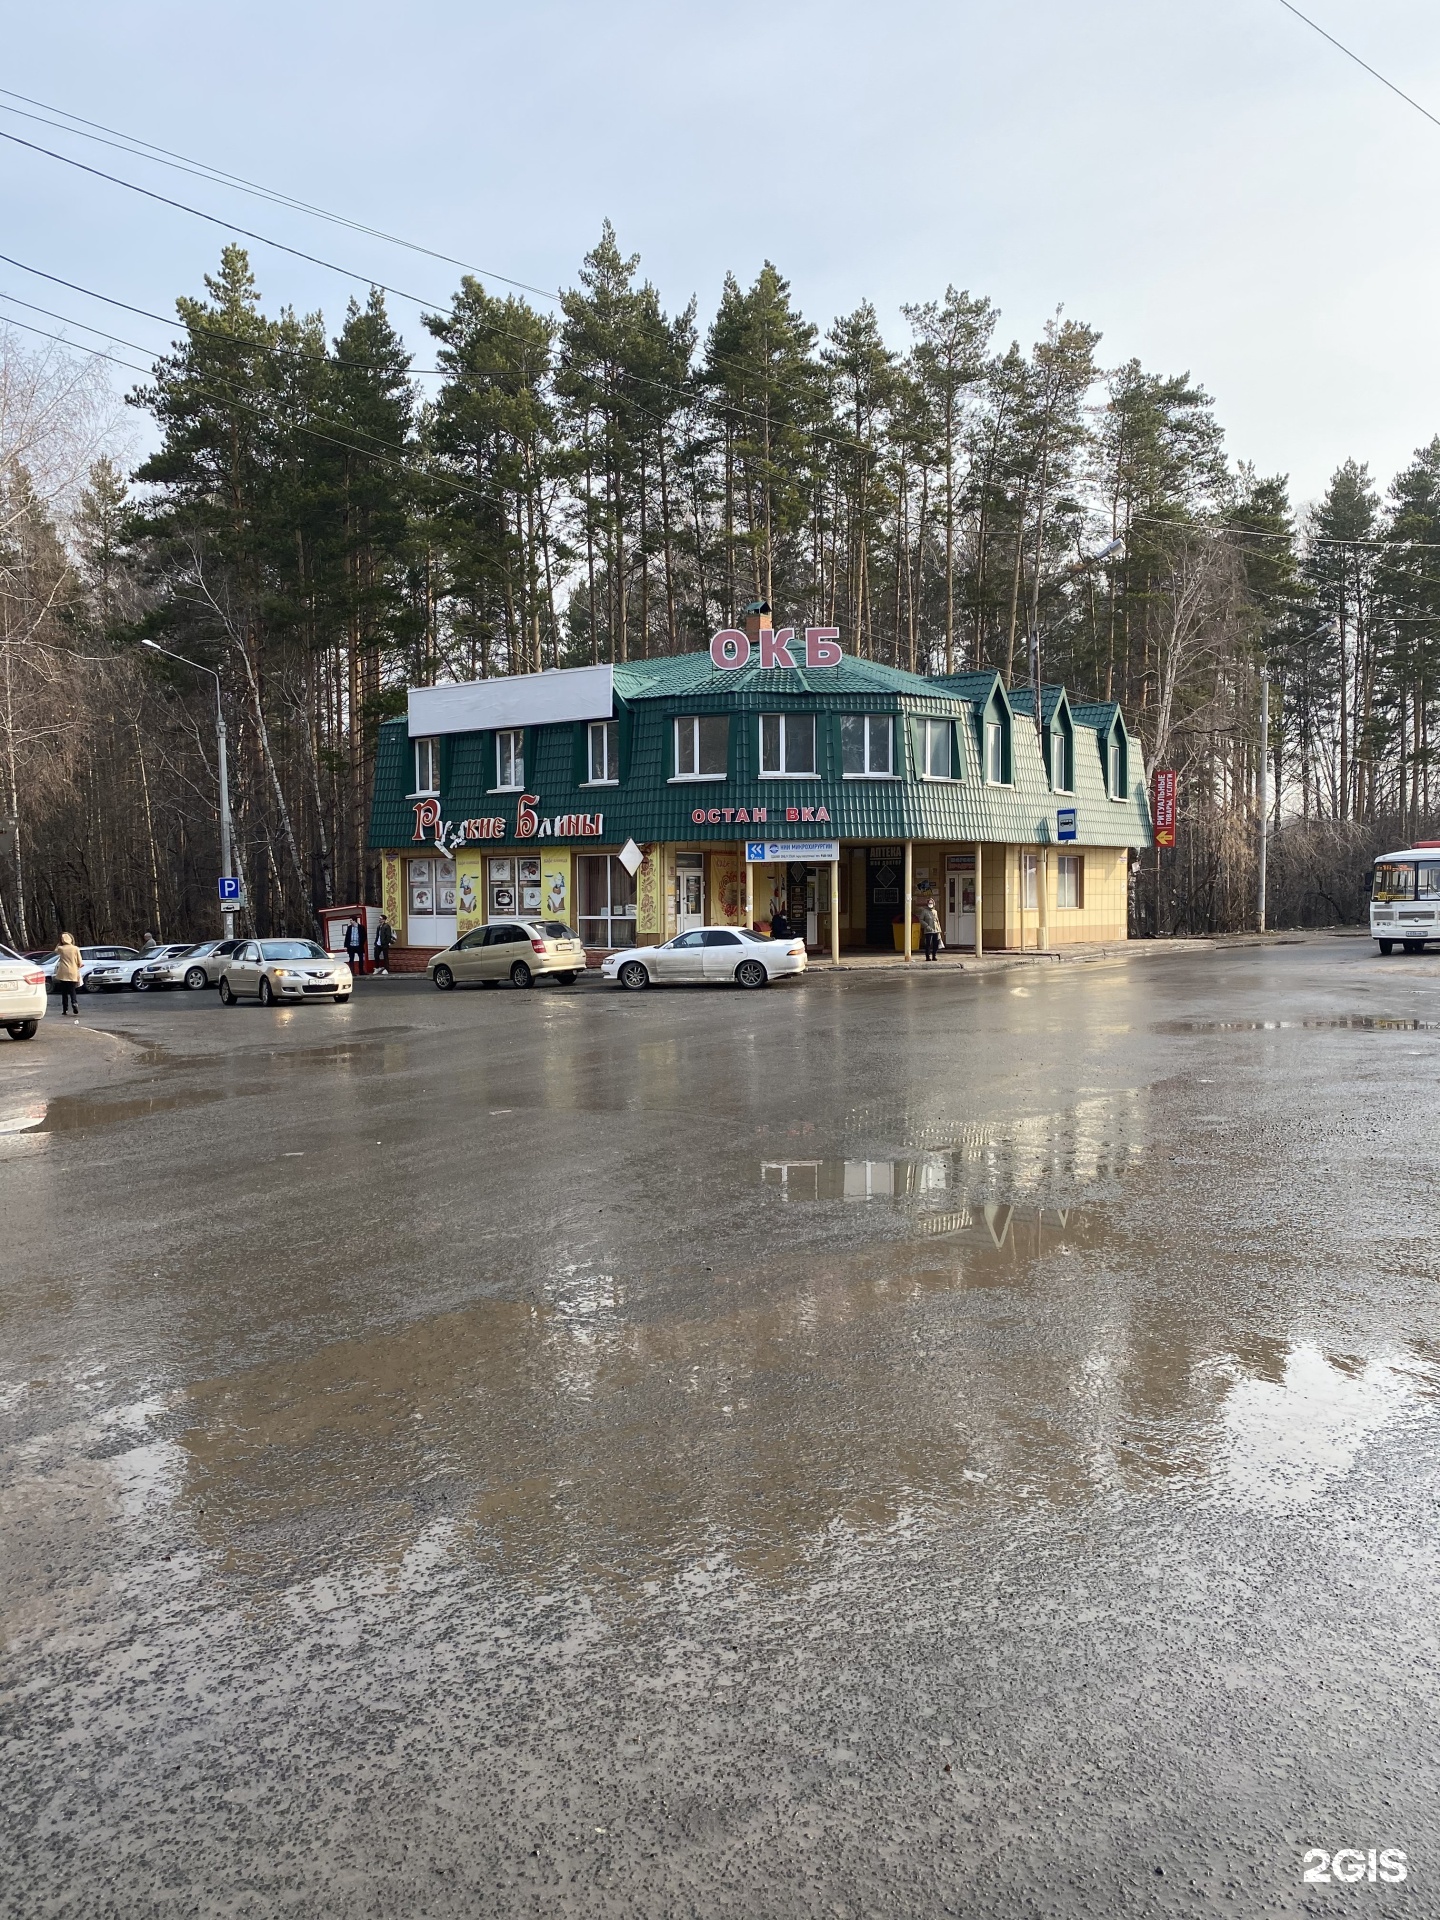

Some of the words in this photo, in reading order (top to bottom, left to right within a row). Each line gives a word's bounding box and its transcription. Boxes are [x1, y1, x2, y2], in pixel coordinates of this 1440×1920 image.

[709, 626, 843, 671] ОКБ
[1157, 773, 1166, 826] РИТУАЛЬНЫЕ
[870, 846, 902, 858] АПТЕКА
[224, 880, 236, 897] P
